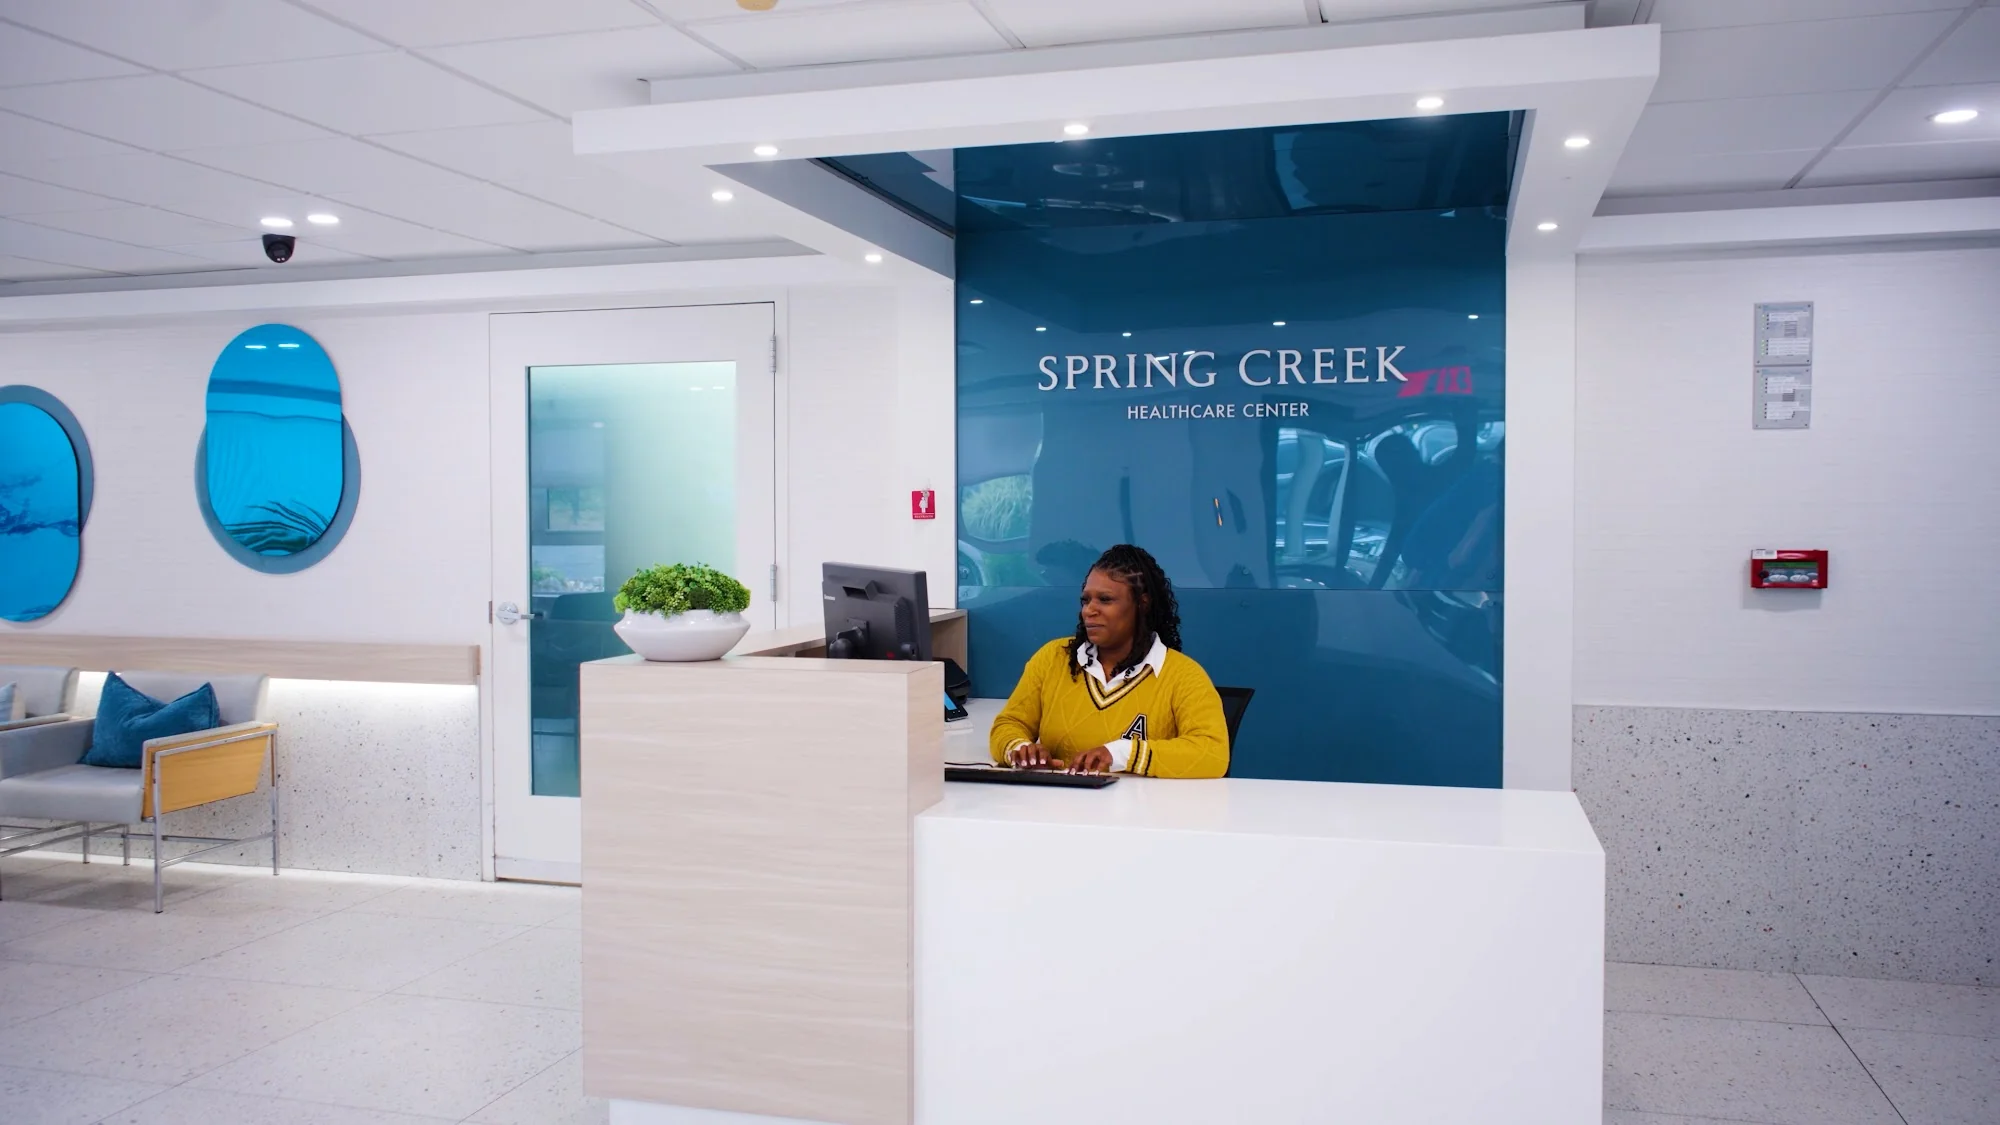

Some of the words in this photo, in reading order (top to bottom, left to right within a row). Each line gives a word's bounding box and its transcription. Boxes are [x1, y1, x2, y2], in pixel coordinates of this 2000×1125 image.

[1038, 351, 1217, 391] SPRING
[1238, 346, 1409, 386] CREEK
[1127, 404, 1236, 420] HEALTHCARE
[1242, 402, 1309, 418] CENTER
[1121, 714, 1148, 741] A
